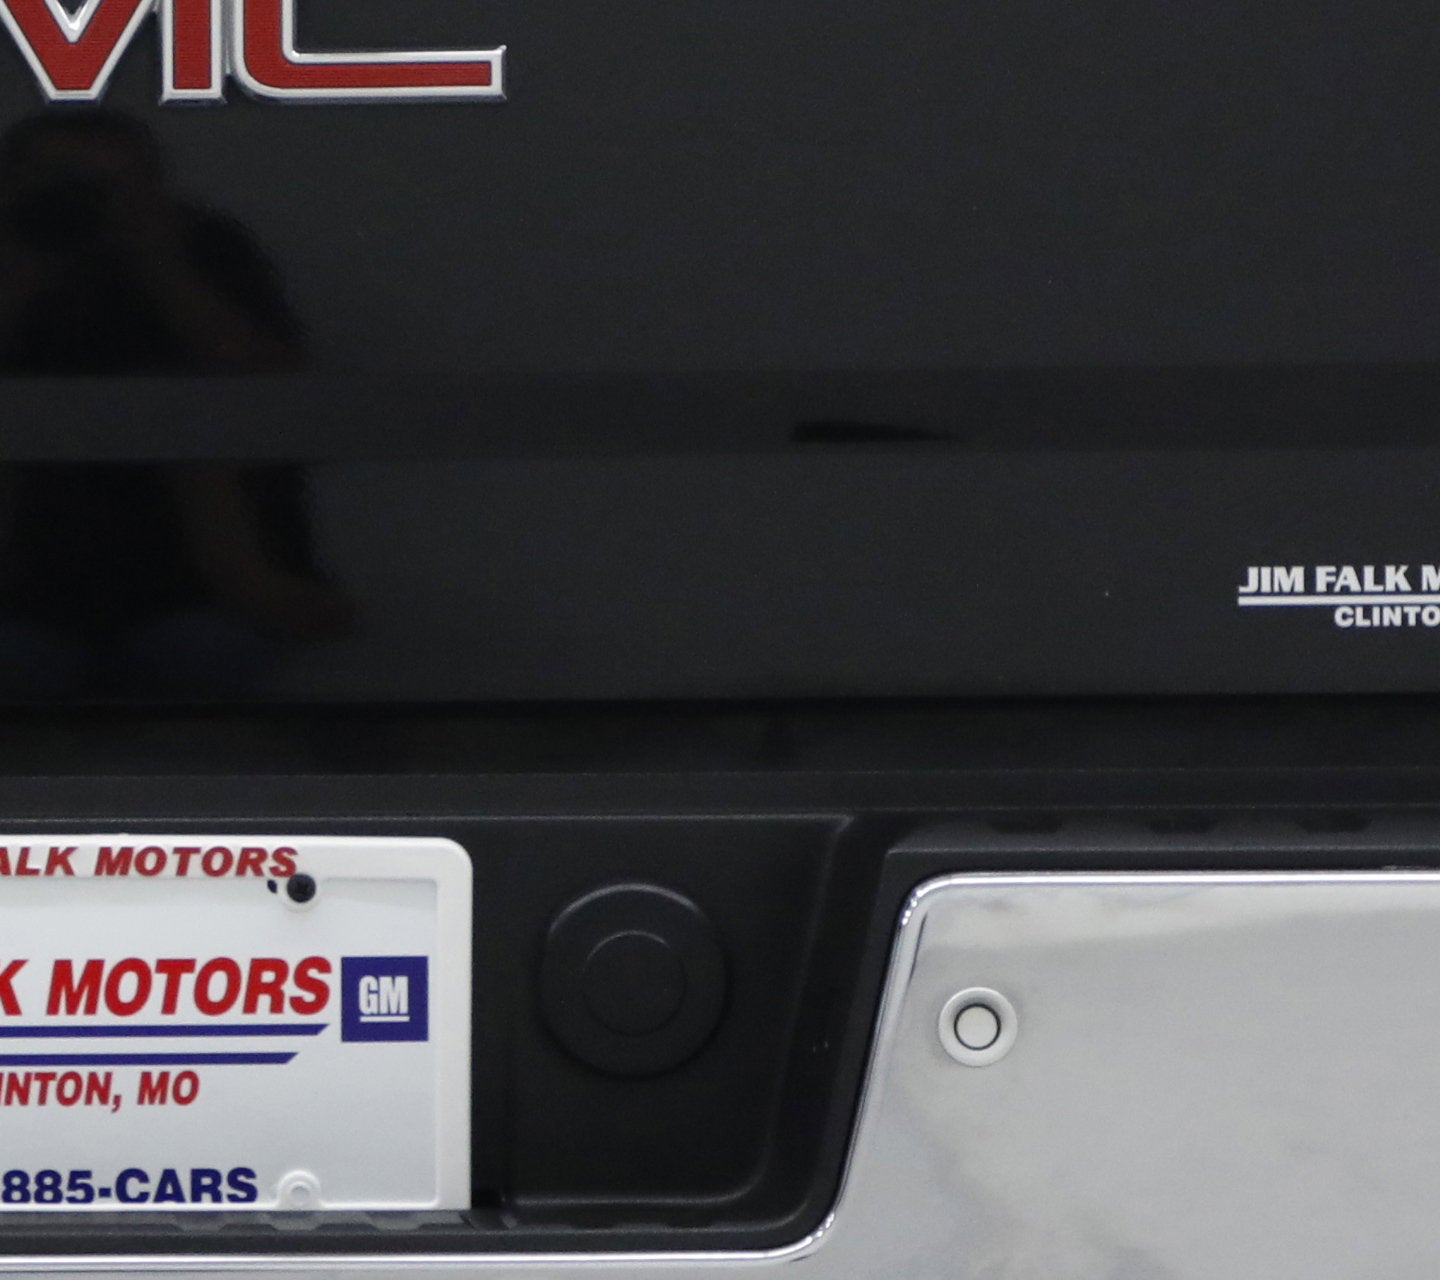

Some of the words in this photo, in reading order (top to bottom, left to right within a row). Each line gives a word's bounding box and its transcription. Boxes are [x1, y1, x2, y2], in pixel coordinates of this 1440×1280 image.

[1238, 565, 1305, 594] JIM
[1315, 564, 1412, 593] FALK
[94, 845, 299, 878] MOTORS
[46, 956, 333, 1017] MOTORS
[357, 974, 411, 1017] GM
[137, 1070, 201, 1107] MO
